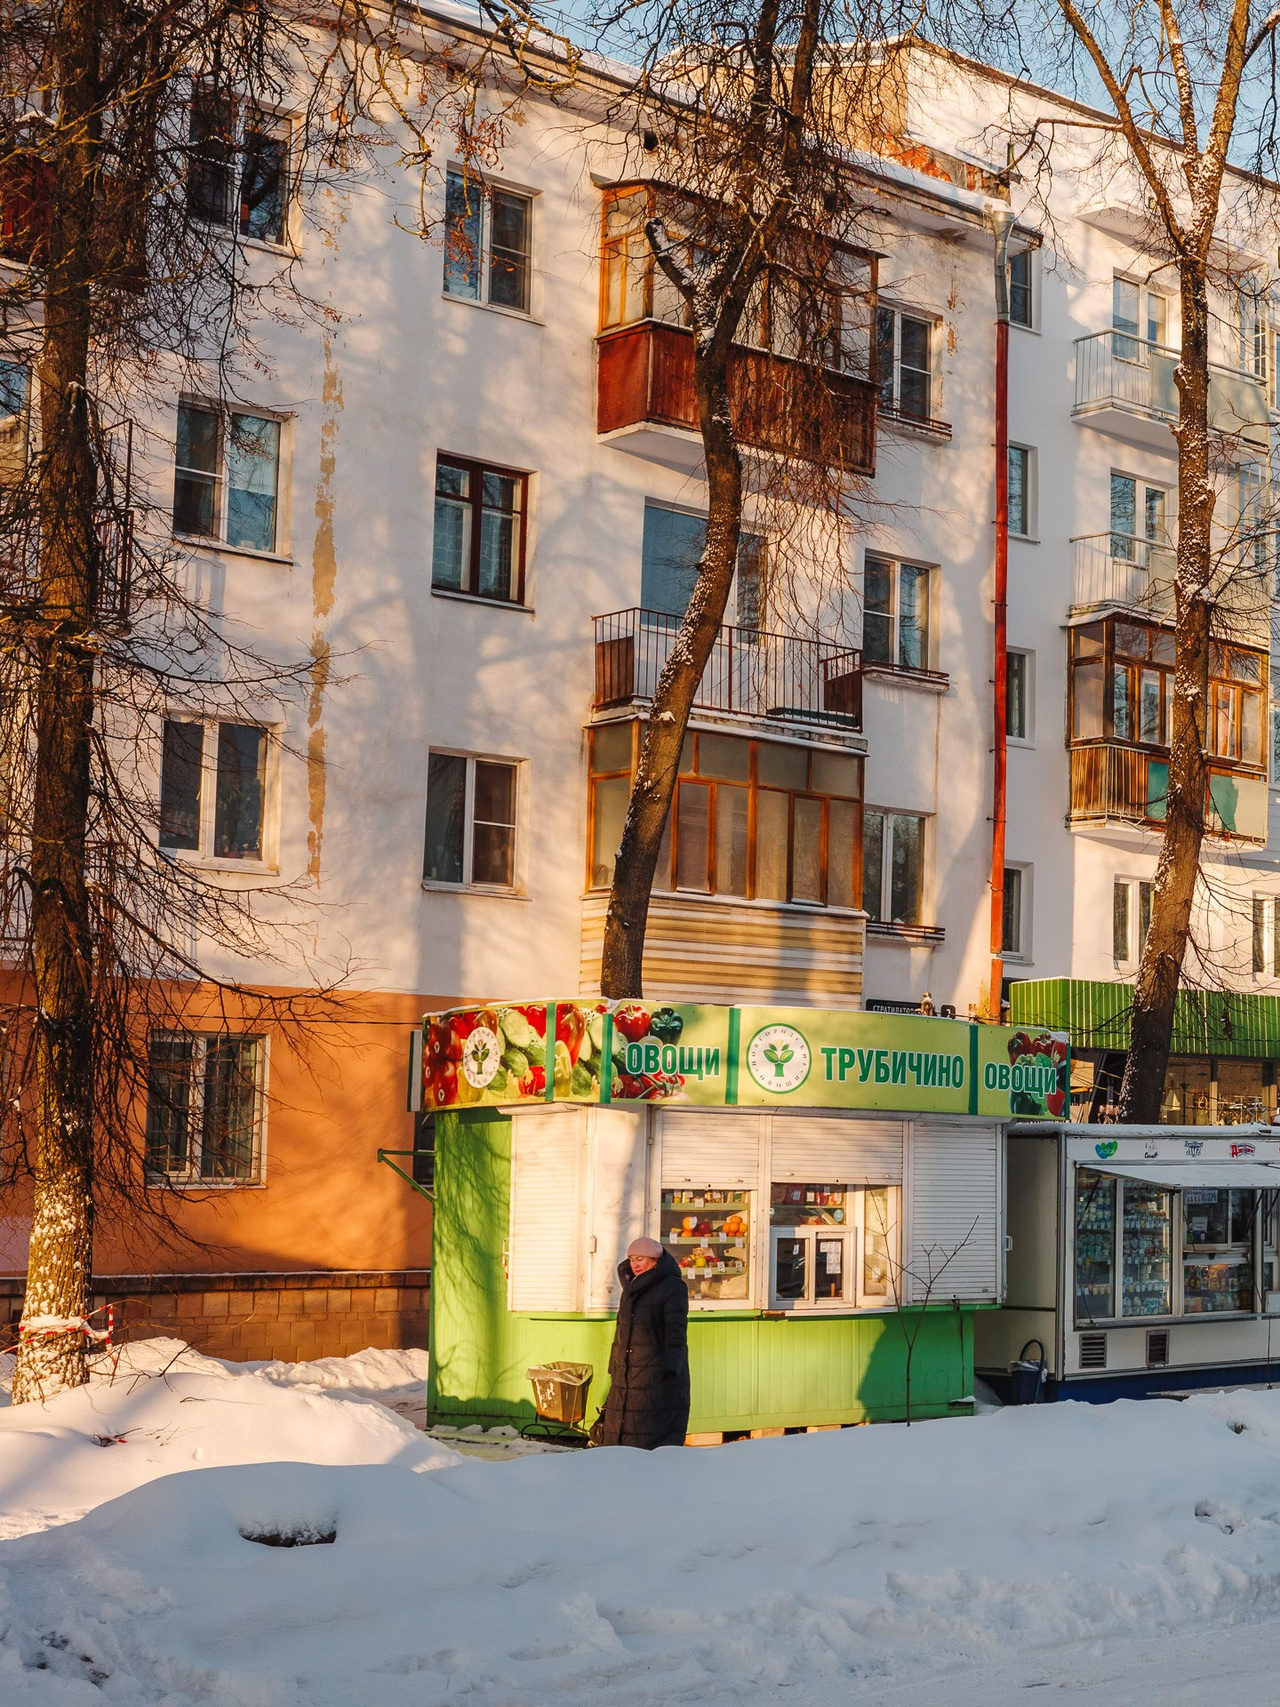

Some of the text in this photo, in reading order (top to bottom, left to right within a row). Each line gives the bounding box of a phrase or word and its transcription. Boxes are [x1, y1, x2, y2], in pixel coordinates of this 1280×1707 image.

[627, 1042, 720, 1081] ОВОЩИ
[820, 1047, 964, 1089] ТРУБИЧИНО
[984, 1062, 1056, 1098] ОВОЩИ
